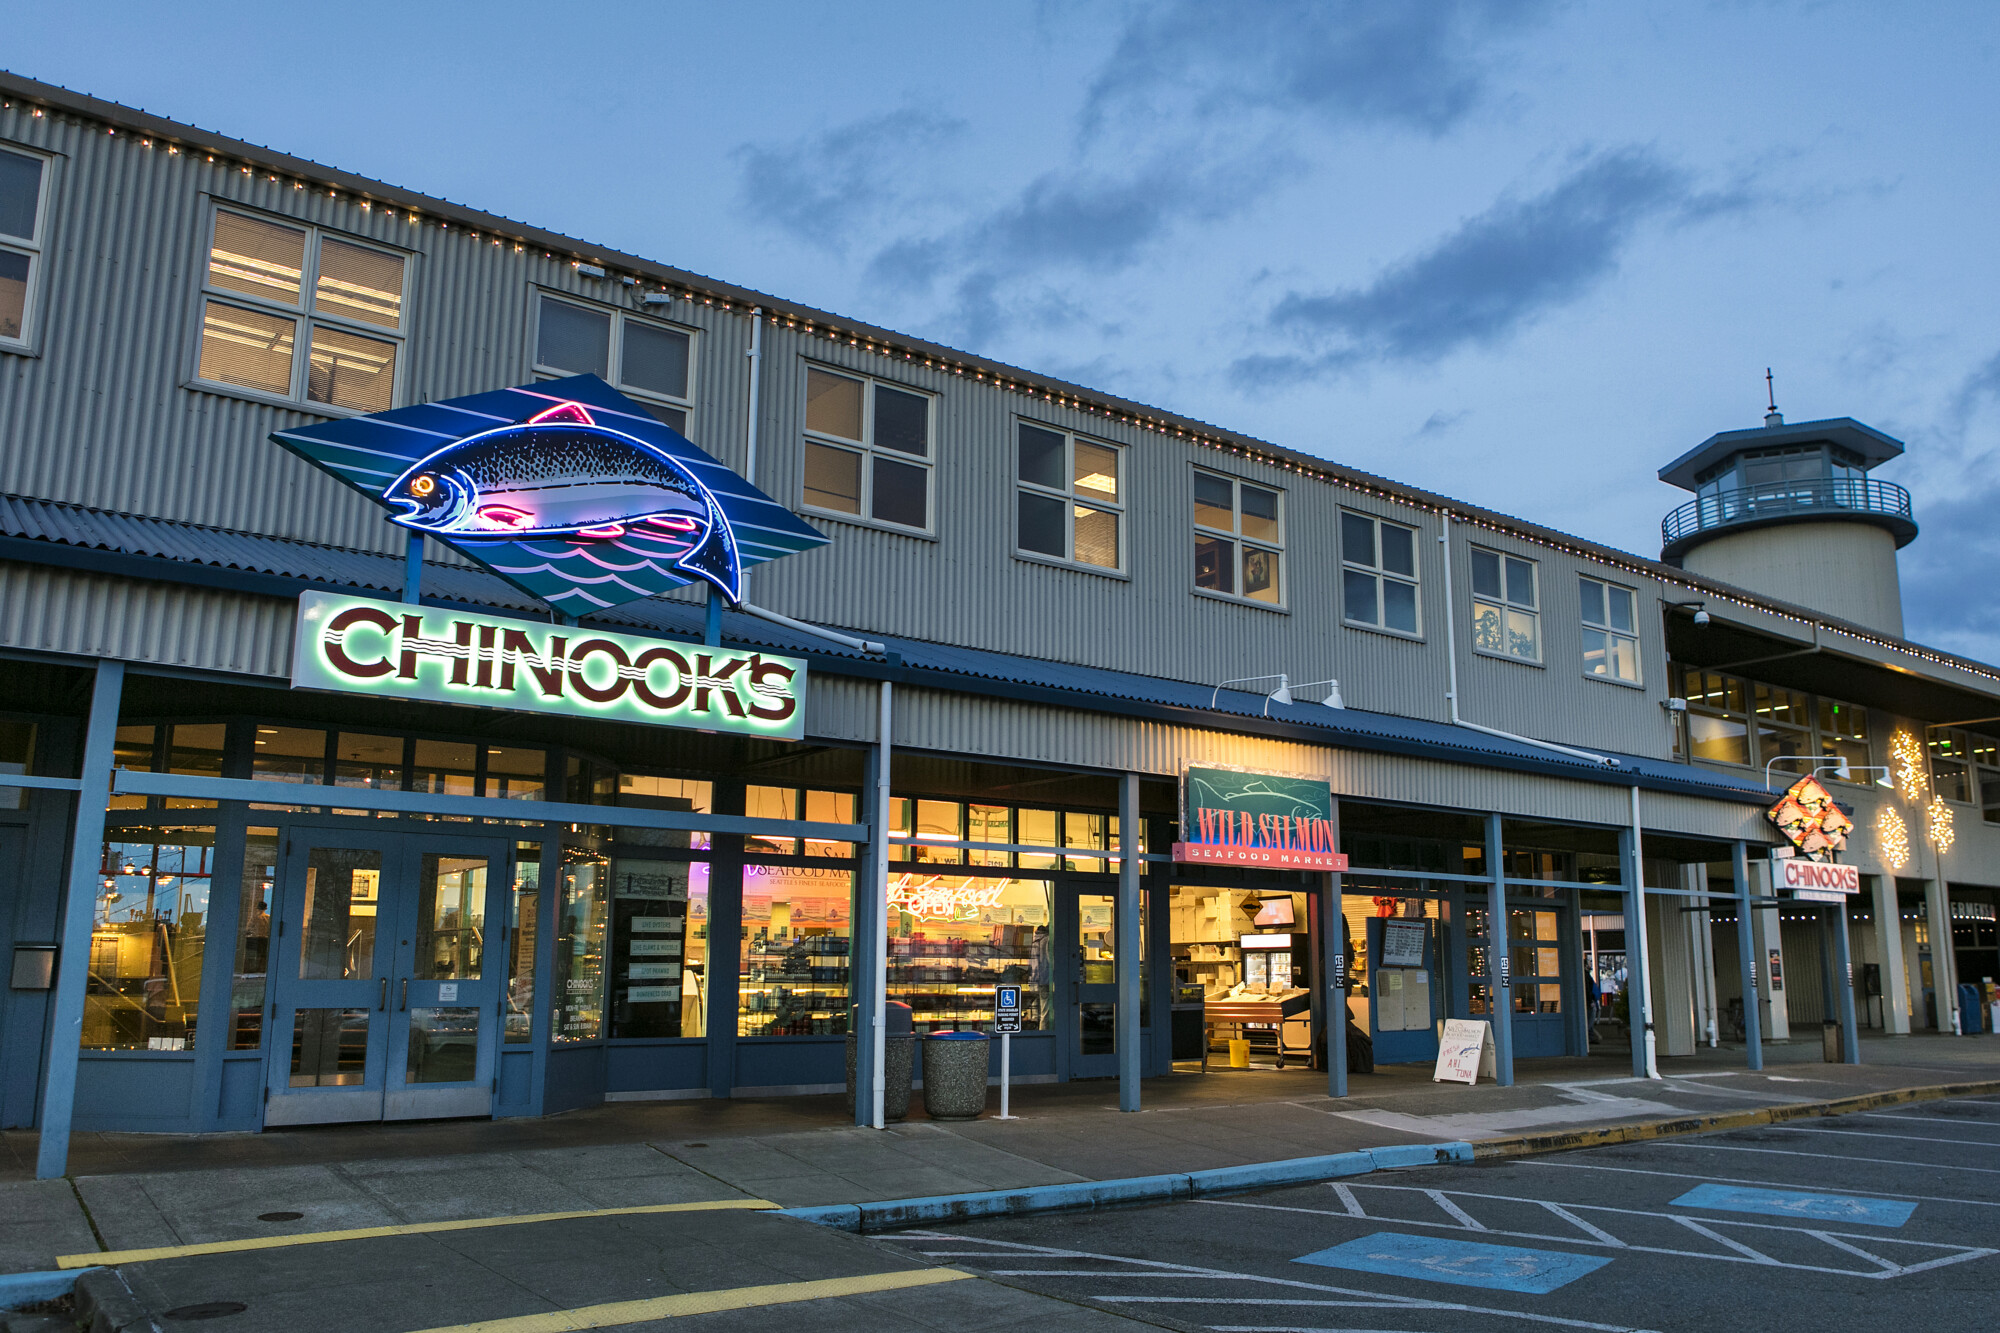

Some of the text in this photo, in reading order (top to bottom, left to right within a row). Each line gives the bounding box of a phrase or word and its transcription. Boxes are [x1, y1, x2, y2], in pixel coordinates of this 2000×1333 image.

[324, 607, 796, 720] CHINOOK'S
[1198, 808, 1335, 853] WILD SALMON
[1192, 849, 1342, 866] SEAFOOD MARKET
[1786, 863, 1857, 890] CHINOOK'S
[908, 897, 955, 916] OPEN
